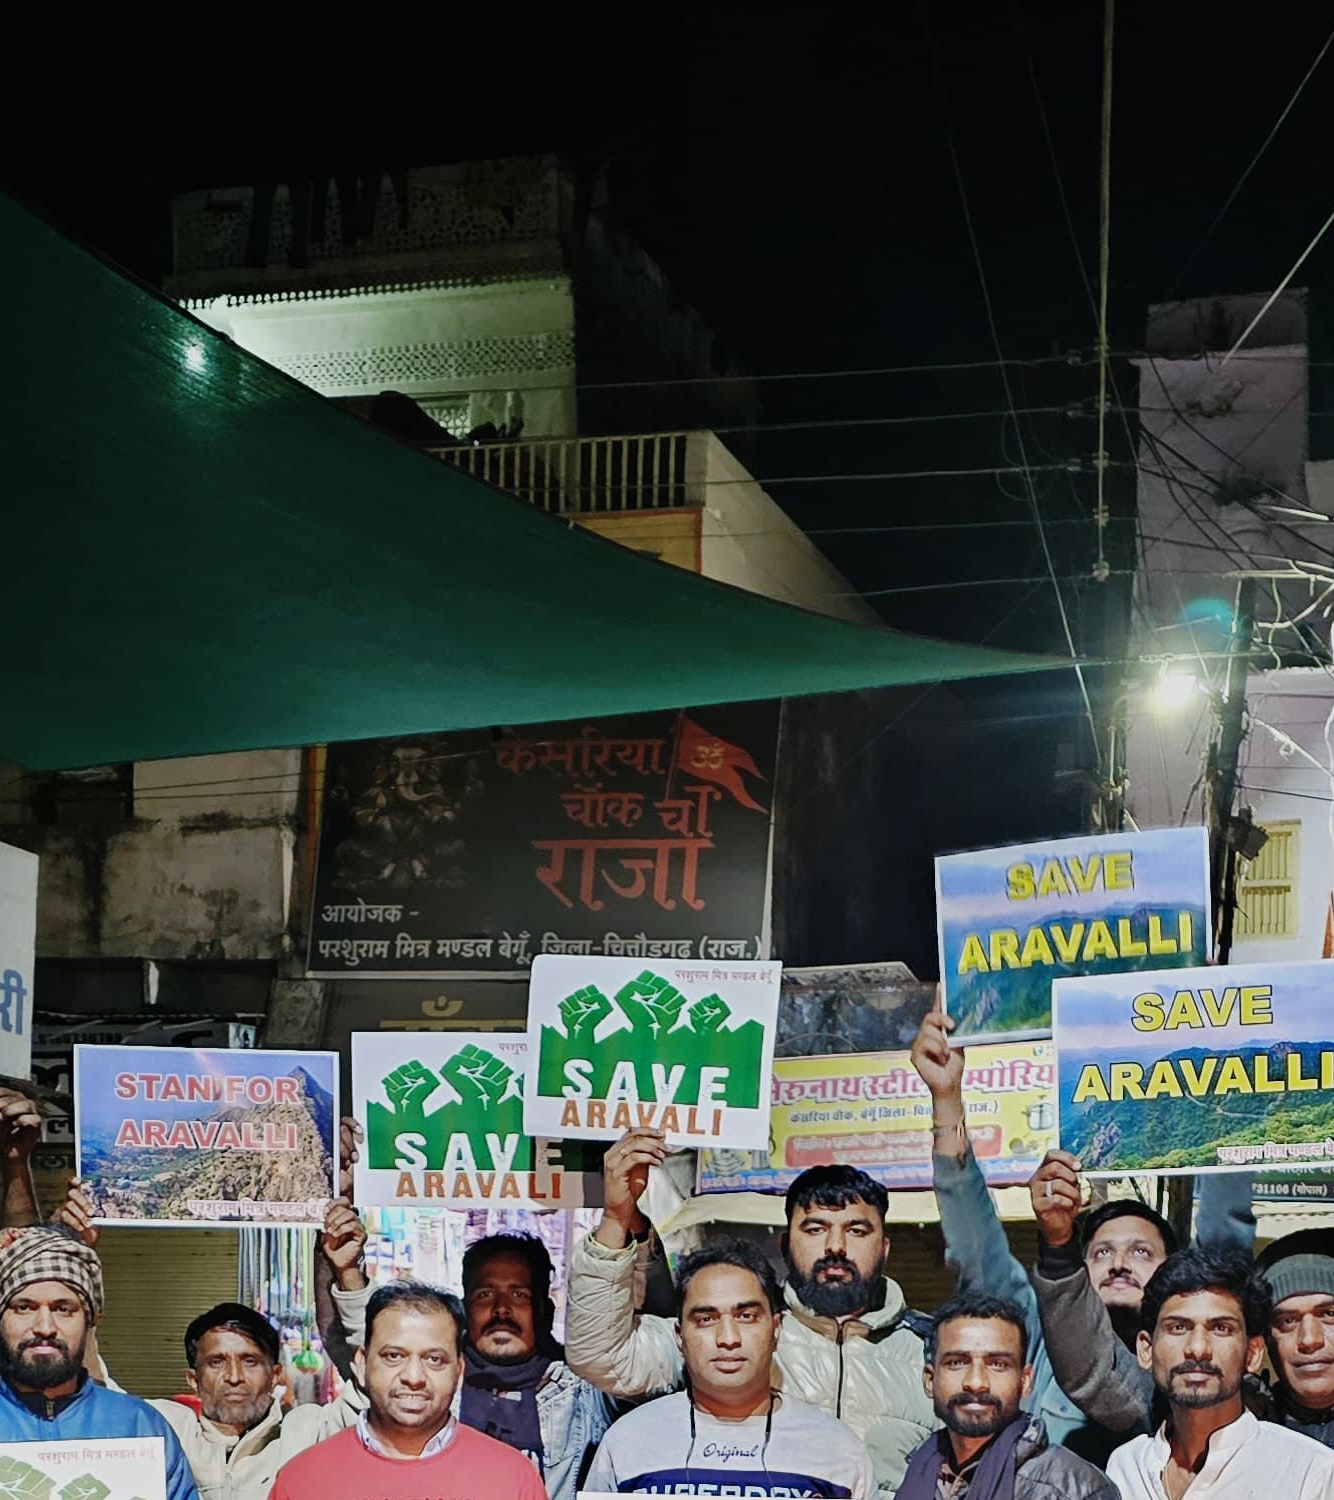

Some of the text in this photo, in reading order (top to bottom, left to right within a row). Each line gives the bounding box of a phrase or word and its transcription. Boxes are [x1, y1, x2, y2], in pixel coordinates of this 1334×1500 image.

[533, 838, 716, 911] राजा
[1007, 850, 1134, 902] SAVE
[322, 898, 403, 923] आयोजक
[319, 938, 390, 966] परशुराम
[395, 932, 431, 958] मित्र
[436, 938, 493, 958] मण्डल
[957, 911, 1194, 976] ARAVALLI
[1131, 984, 1273, 1033] SAVE
[225, 1075, 300, 1104] FOR
[562, 1058, 730, 1107] SAVE
[115, 1119, 298, 1150] ARAVALLI
[561, 1099, 723, 1136] ARAVALI
[395, 1132, 566, 1174] SAVE
[395, 1172, 562, 1200] ARAVALI
[703, 1442, 759, 1464] Original
